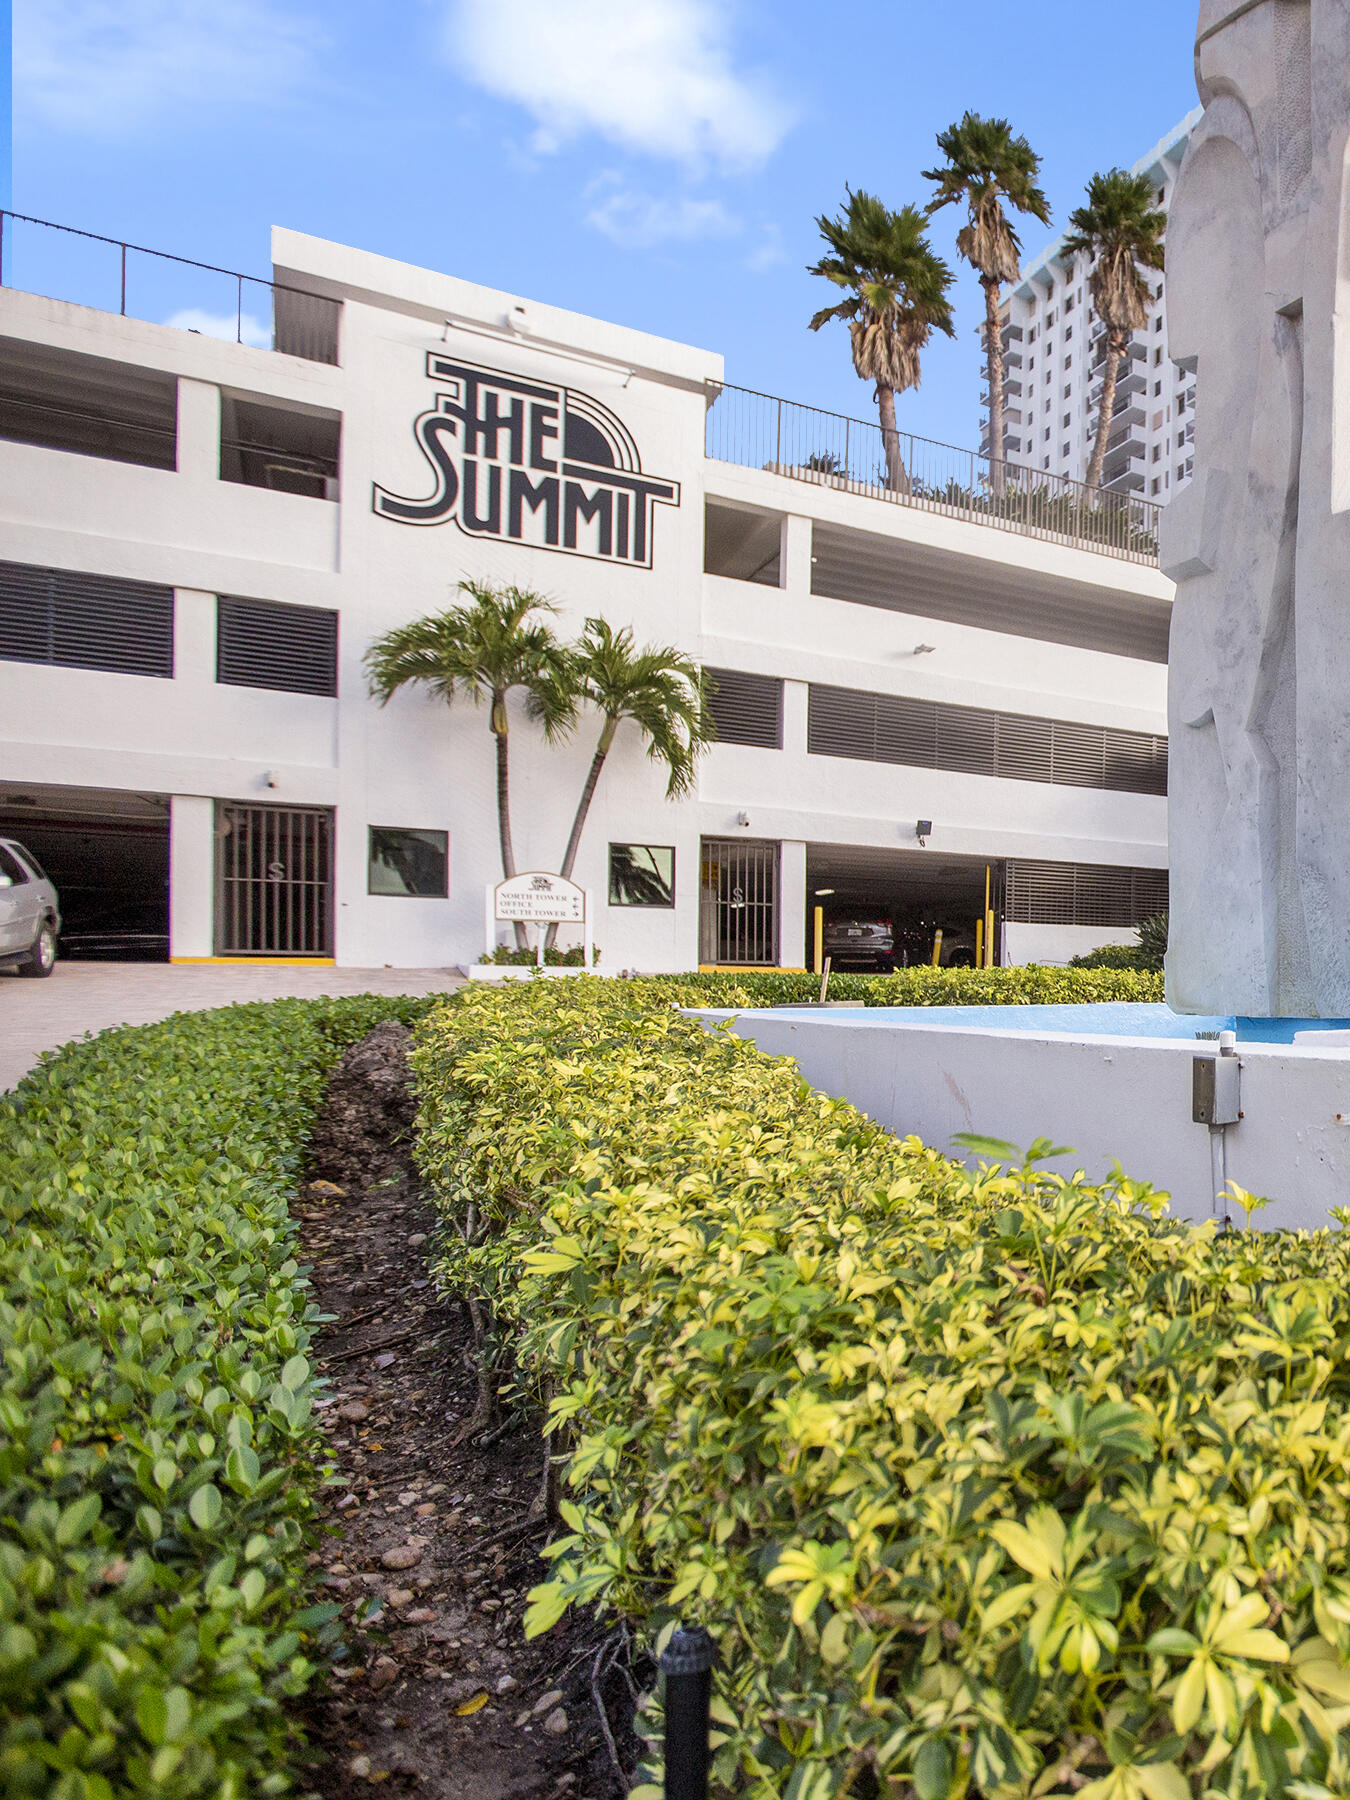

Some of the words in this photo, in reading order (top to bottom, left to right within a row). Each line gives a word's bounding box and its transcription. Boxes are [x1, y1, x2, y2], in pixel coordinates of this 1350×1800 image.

[434, 360, 559, 475] THE
[379, 416, 675, 564] SUMMIT
[535, 894, 567, 902] TOWER
[500, 900, 533, 908] OFFICE
[500, 908, 532, 916] SOUTH
